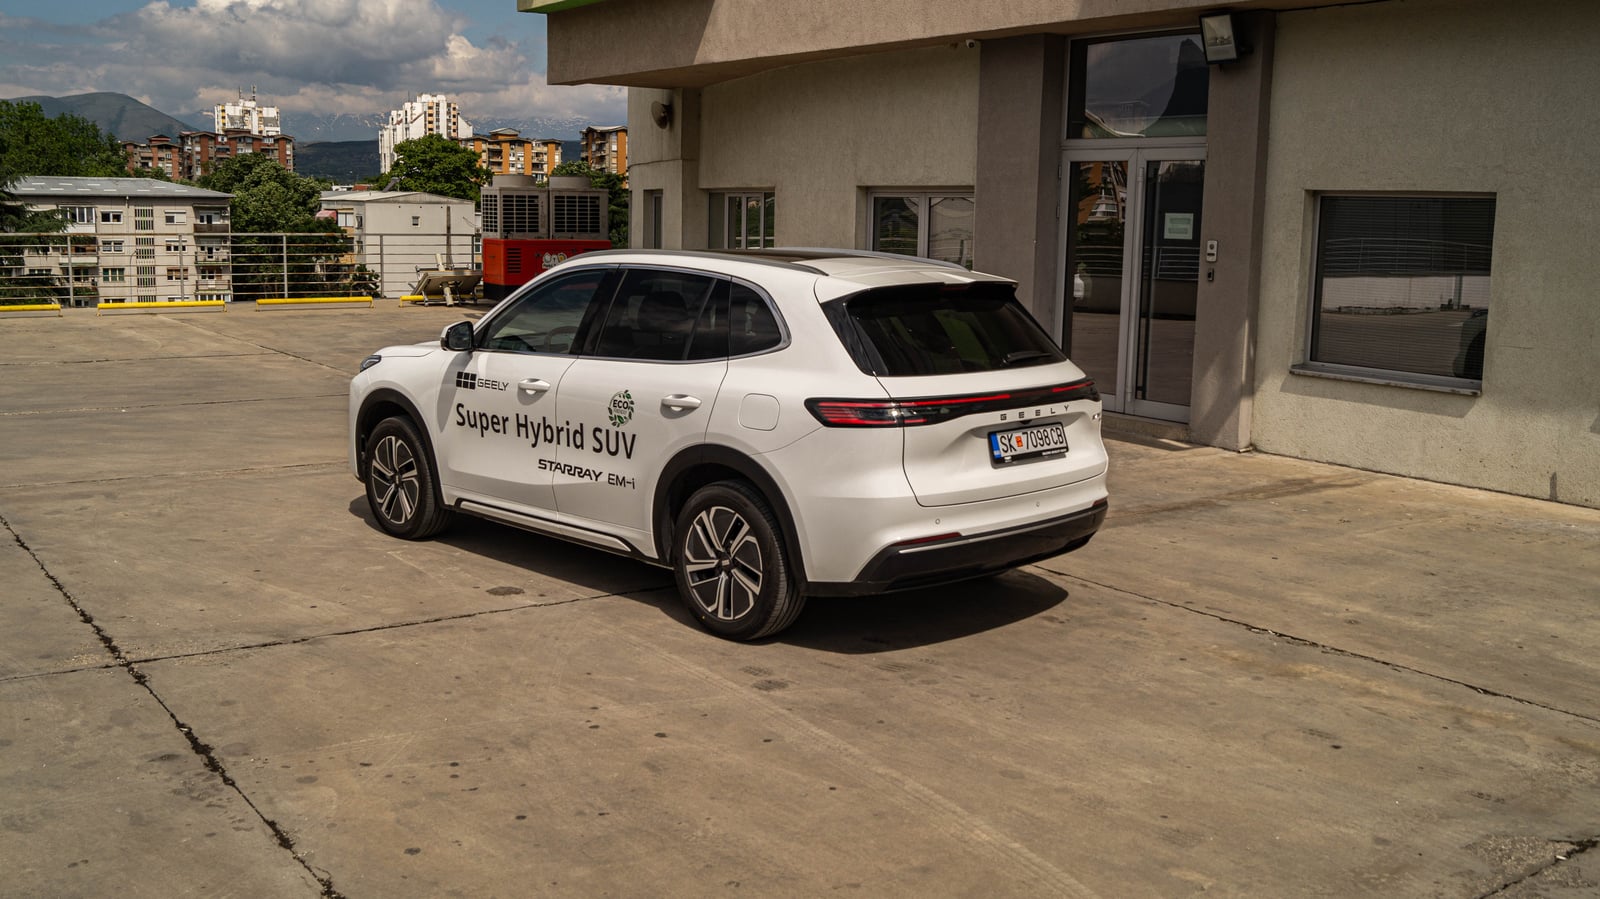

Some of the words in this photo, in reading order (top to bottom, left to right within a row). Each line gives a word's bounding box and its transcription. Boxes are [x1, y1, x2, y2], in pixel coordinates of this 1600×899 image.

[477, 378, 509, 391] GEELY
[613, 399, 629, 409] ECO
[1000, 404, 1070, 421] GEELY
[456, 403, 509, 437] Super
[516, 413, 584, 449] Hybrid
[592, 427, 637, 459] SUV
[1000, 433, 1017, 453] SK
[538, 459, 603, 482] STARRAY
[607, 473, 636, 489] EM-i
